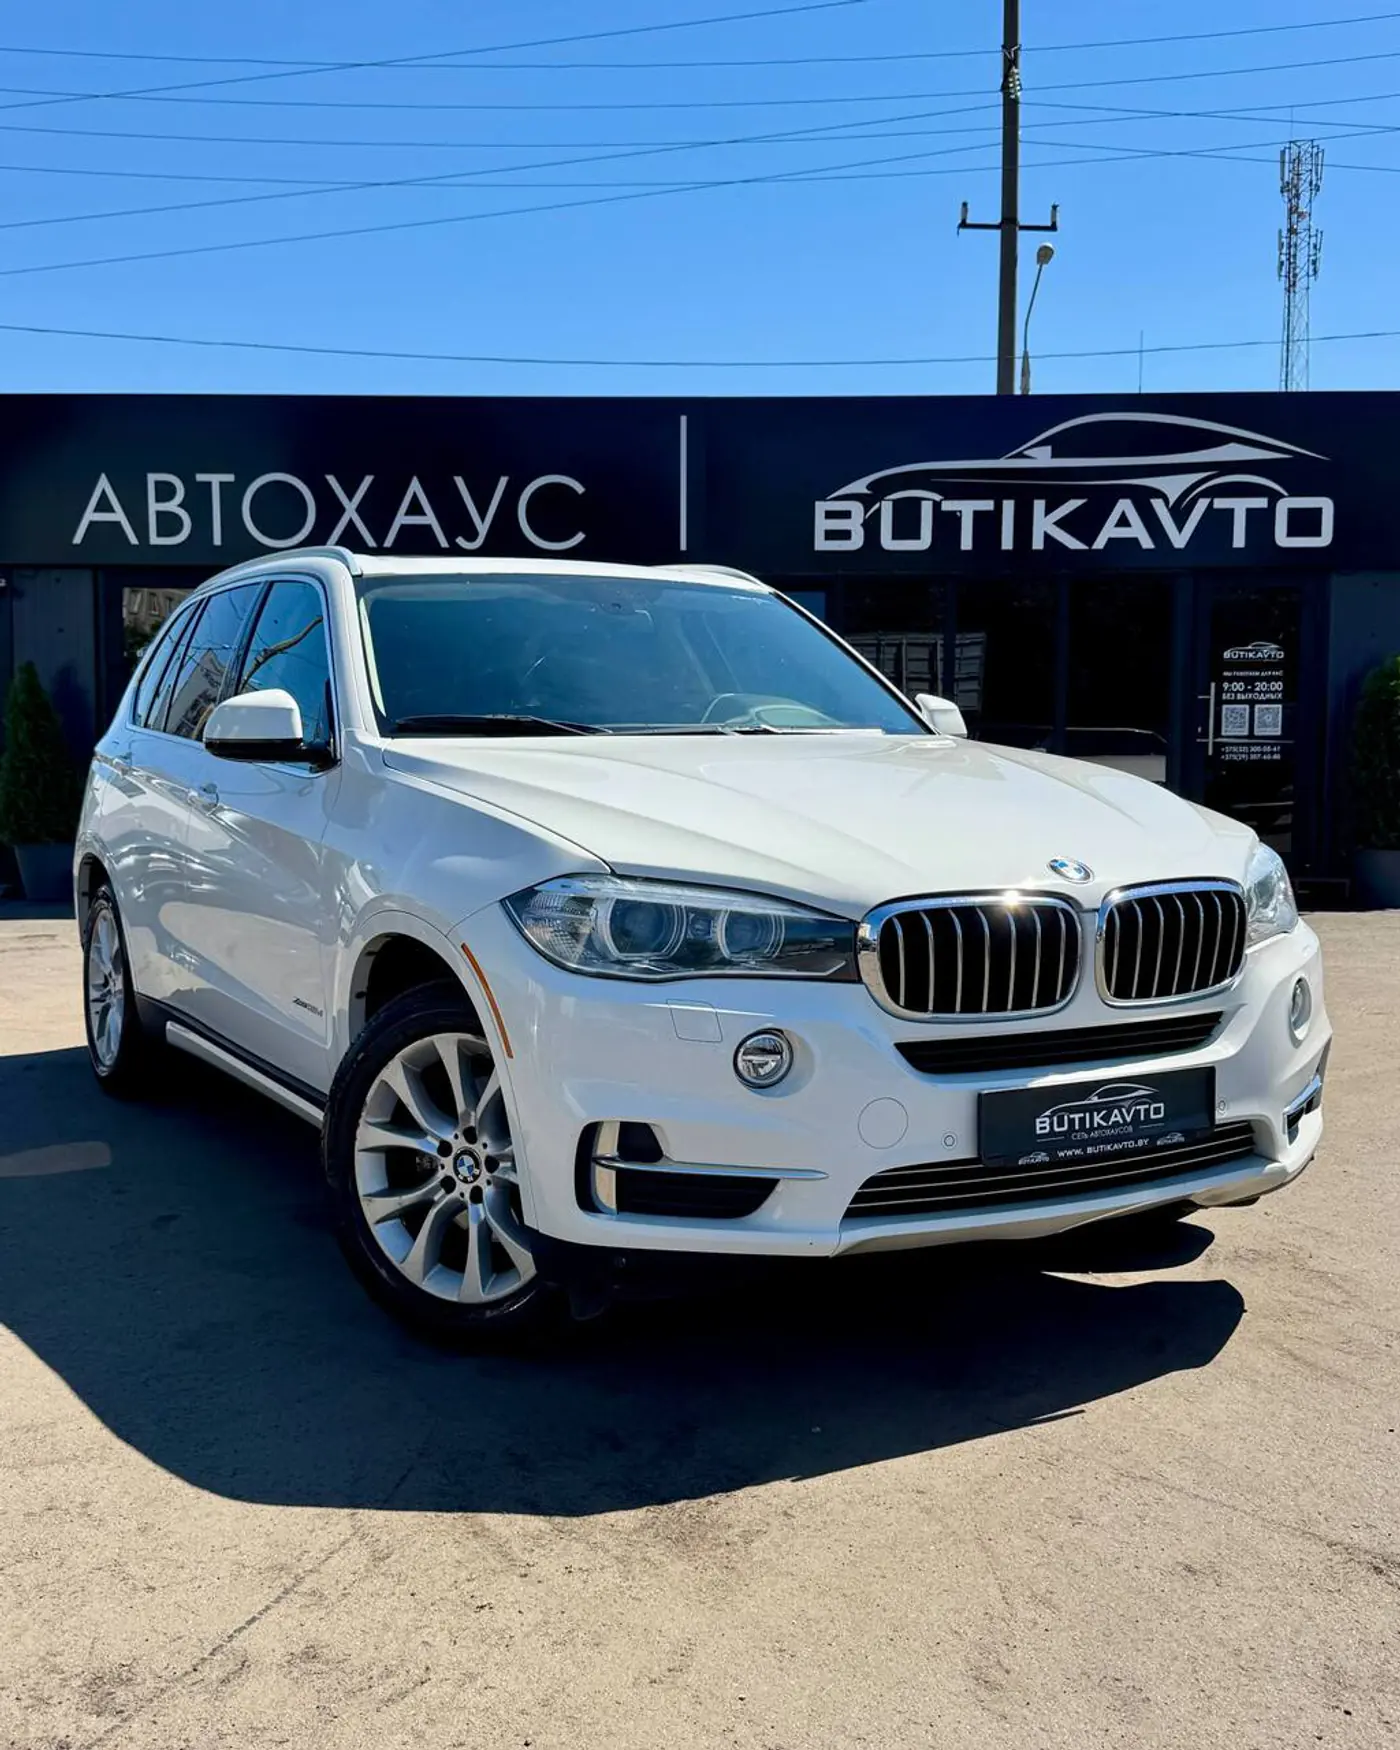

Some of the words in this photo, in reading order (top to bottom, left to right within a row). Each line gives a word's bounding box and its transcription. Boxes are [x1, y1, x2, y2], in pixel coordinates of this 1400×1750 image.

[72, 472, 586, 550] АВТОХАУС
[814, 496, 1335, 552] BUTIKAVTO
[1223, 650, 1284, 659] BUTIKAVTO
[1222, 682, 1245, 692] 9:00
[1254, 681, 1283, 692] 20:00
[1236, 692, 1283, 701] ВЫХОДНЫХ
[1035, 1102, 1165, 1135] BUTIKAVTO
